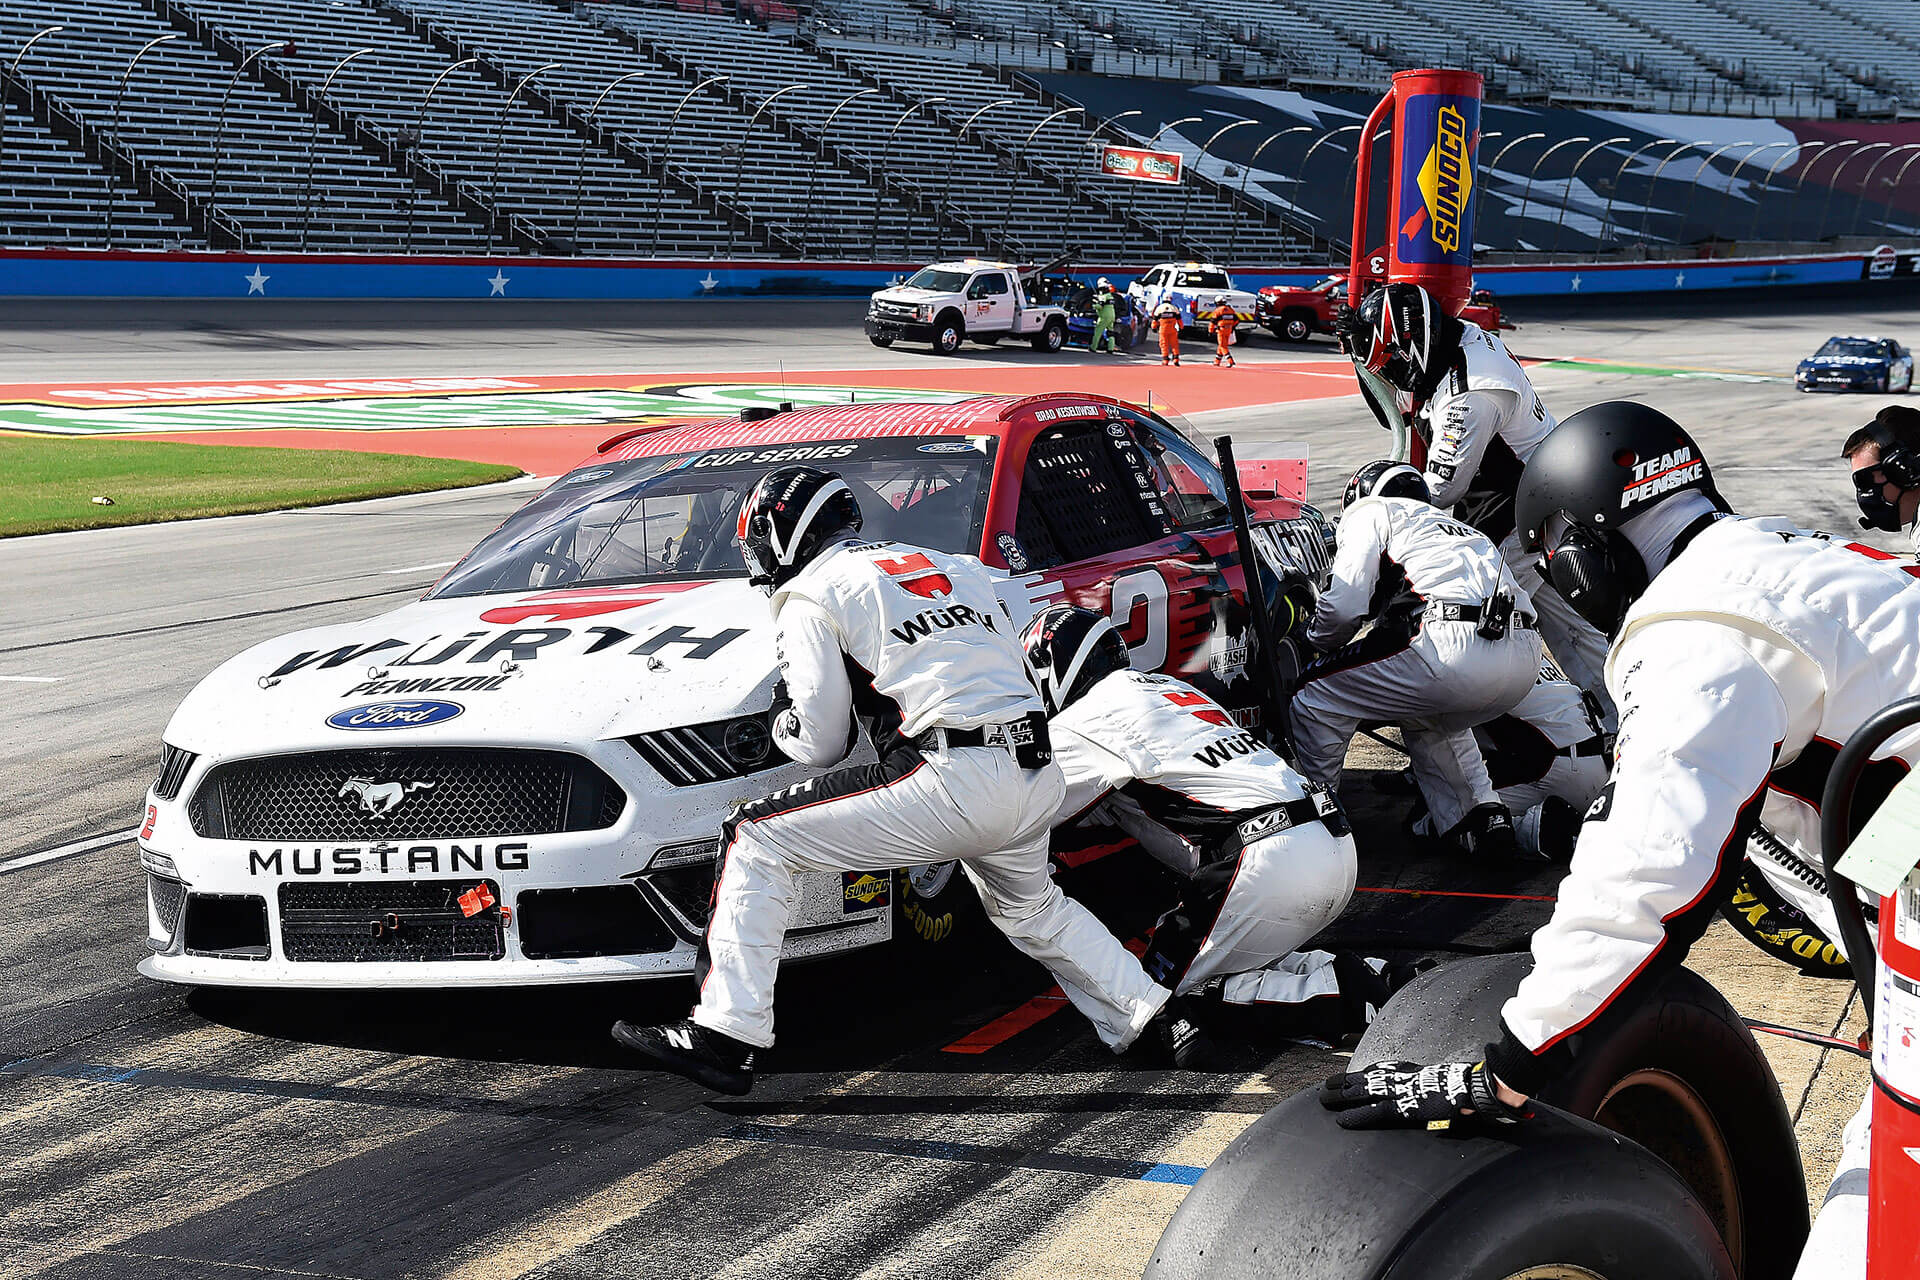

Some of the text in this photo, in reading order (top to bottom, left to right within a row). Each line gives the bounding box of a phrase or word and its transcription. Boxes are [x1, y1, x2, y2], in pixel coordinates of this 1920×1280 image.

[1435, 110, 1464, 247] SUNOCO
[1177, 273, 1188, 285] 2
[1035, 409, 1056, 422] BRAD
[1056, 405, 1099, 418] KESELOWSKI
[695, 444, 858, 468] CUP SERIES
[1632, 446, 1691, 482] TEAM
[780, 472, 807, 501] WURTH
[1620, 463, 1703, 509] PENSKE
[1211, 650, 1247, 671] WABASH
[340, 675, 510, 699] PENNZOIL
[353, 703, 434, 727] Ford
[139, 804, 157, 841] 2
[249, 843, 531, 876] MUSTANG
[846, 880, 889, 897] SUNOCO
